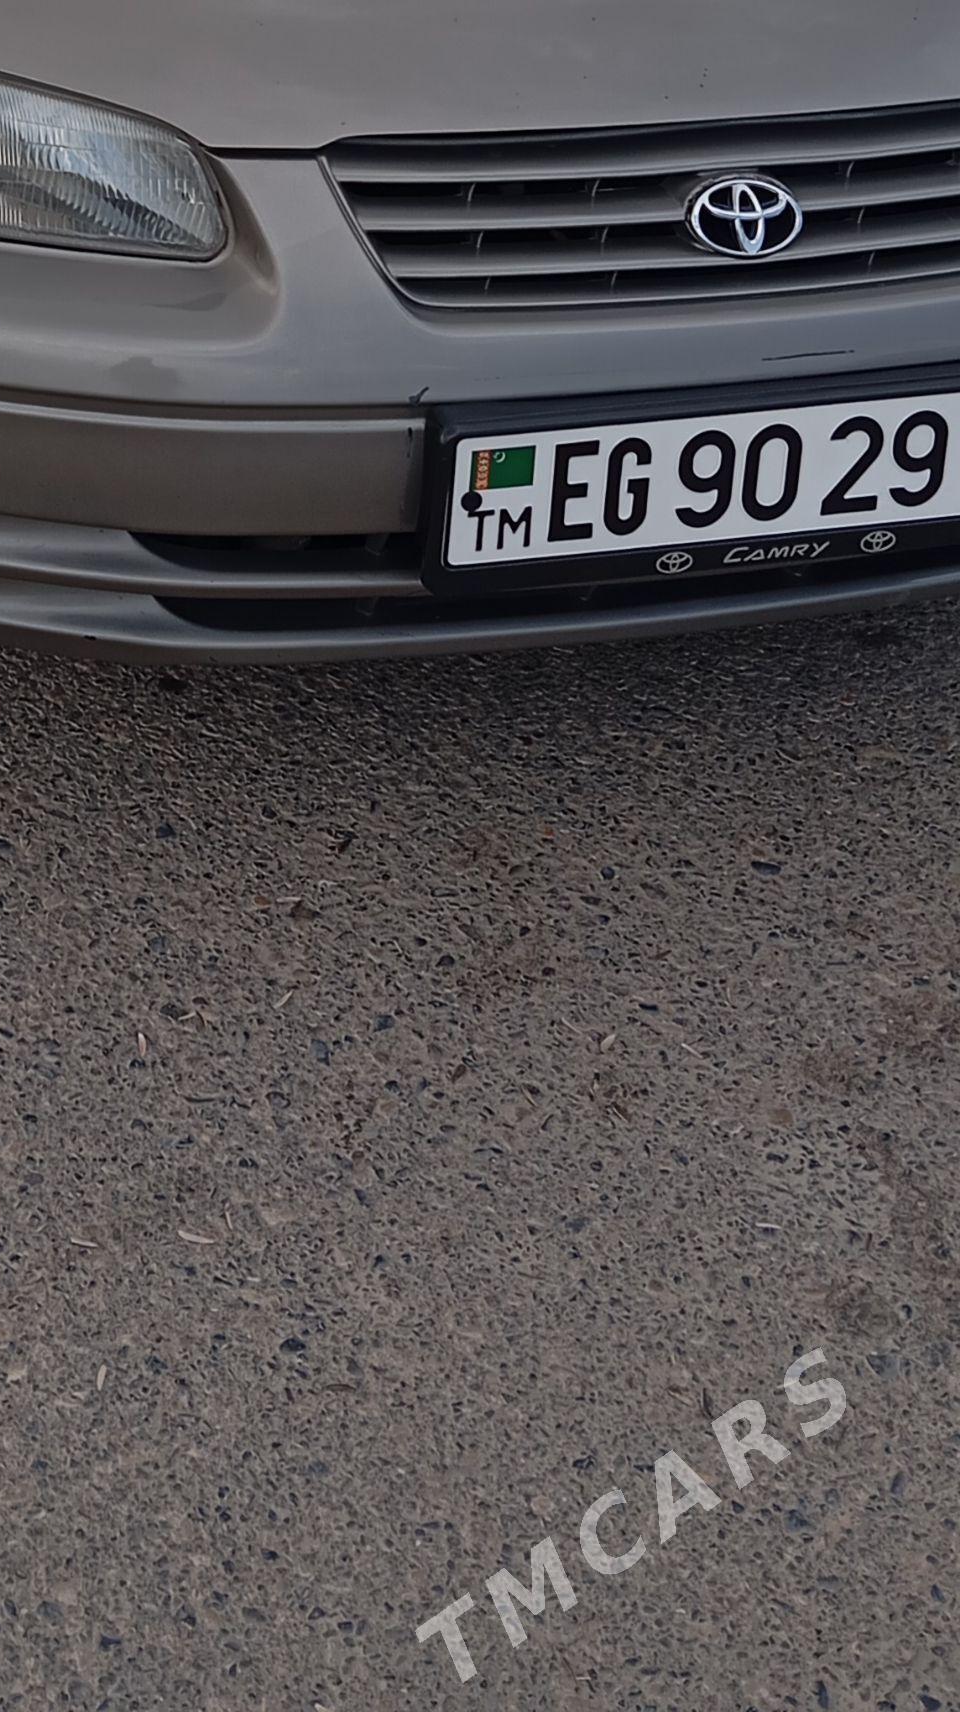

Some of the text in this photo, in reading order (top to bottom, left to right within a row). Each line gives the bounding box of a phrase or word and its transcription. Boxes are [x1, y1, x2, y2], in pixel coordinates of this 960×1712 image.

[546, 409, 950, 544] EG 90 29
[467, 504, 533, 553] TM
[722, 540, 831, 566] CAMRY
